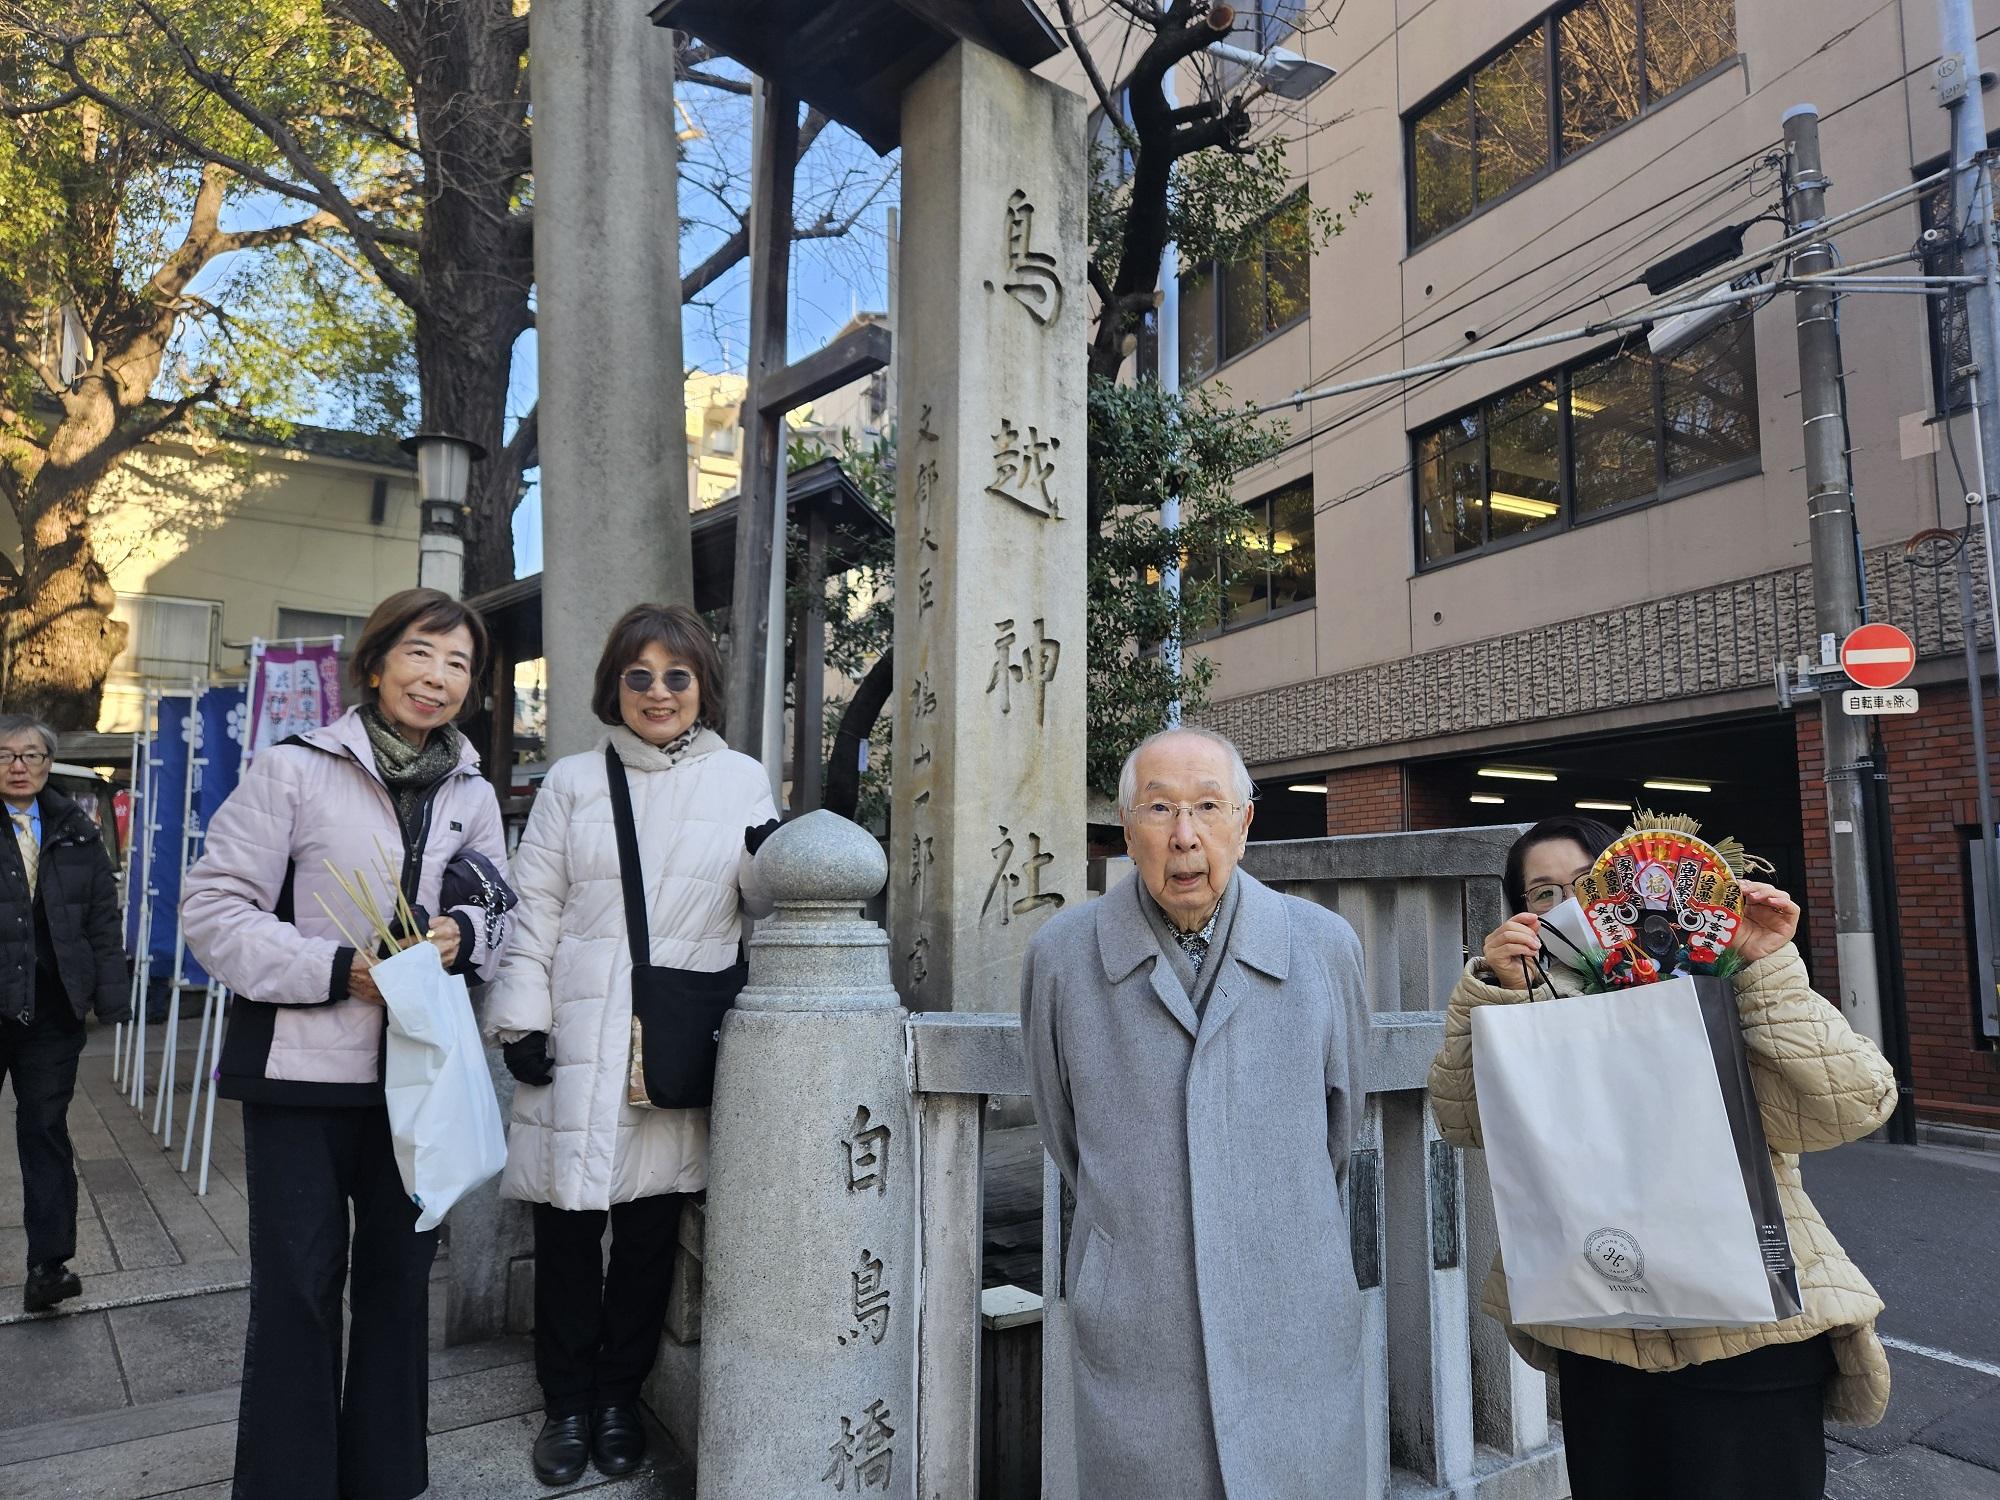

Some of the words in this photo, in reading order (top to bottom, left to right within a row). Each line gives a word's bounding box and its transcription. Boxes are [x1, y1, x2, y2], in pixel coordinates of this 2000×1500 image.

[913, 404, 940, 622] 文部大臣
[983, 188, 1066, 926] 鳥越神社
[1850, 694, 1913, 710] 自転車を除く
[1645, 872, 1667, 895] 福
[821, 1104, 896, 1493] 白鳥橋
